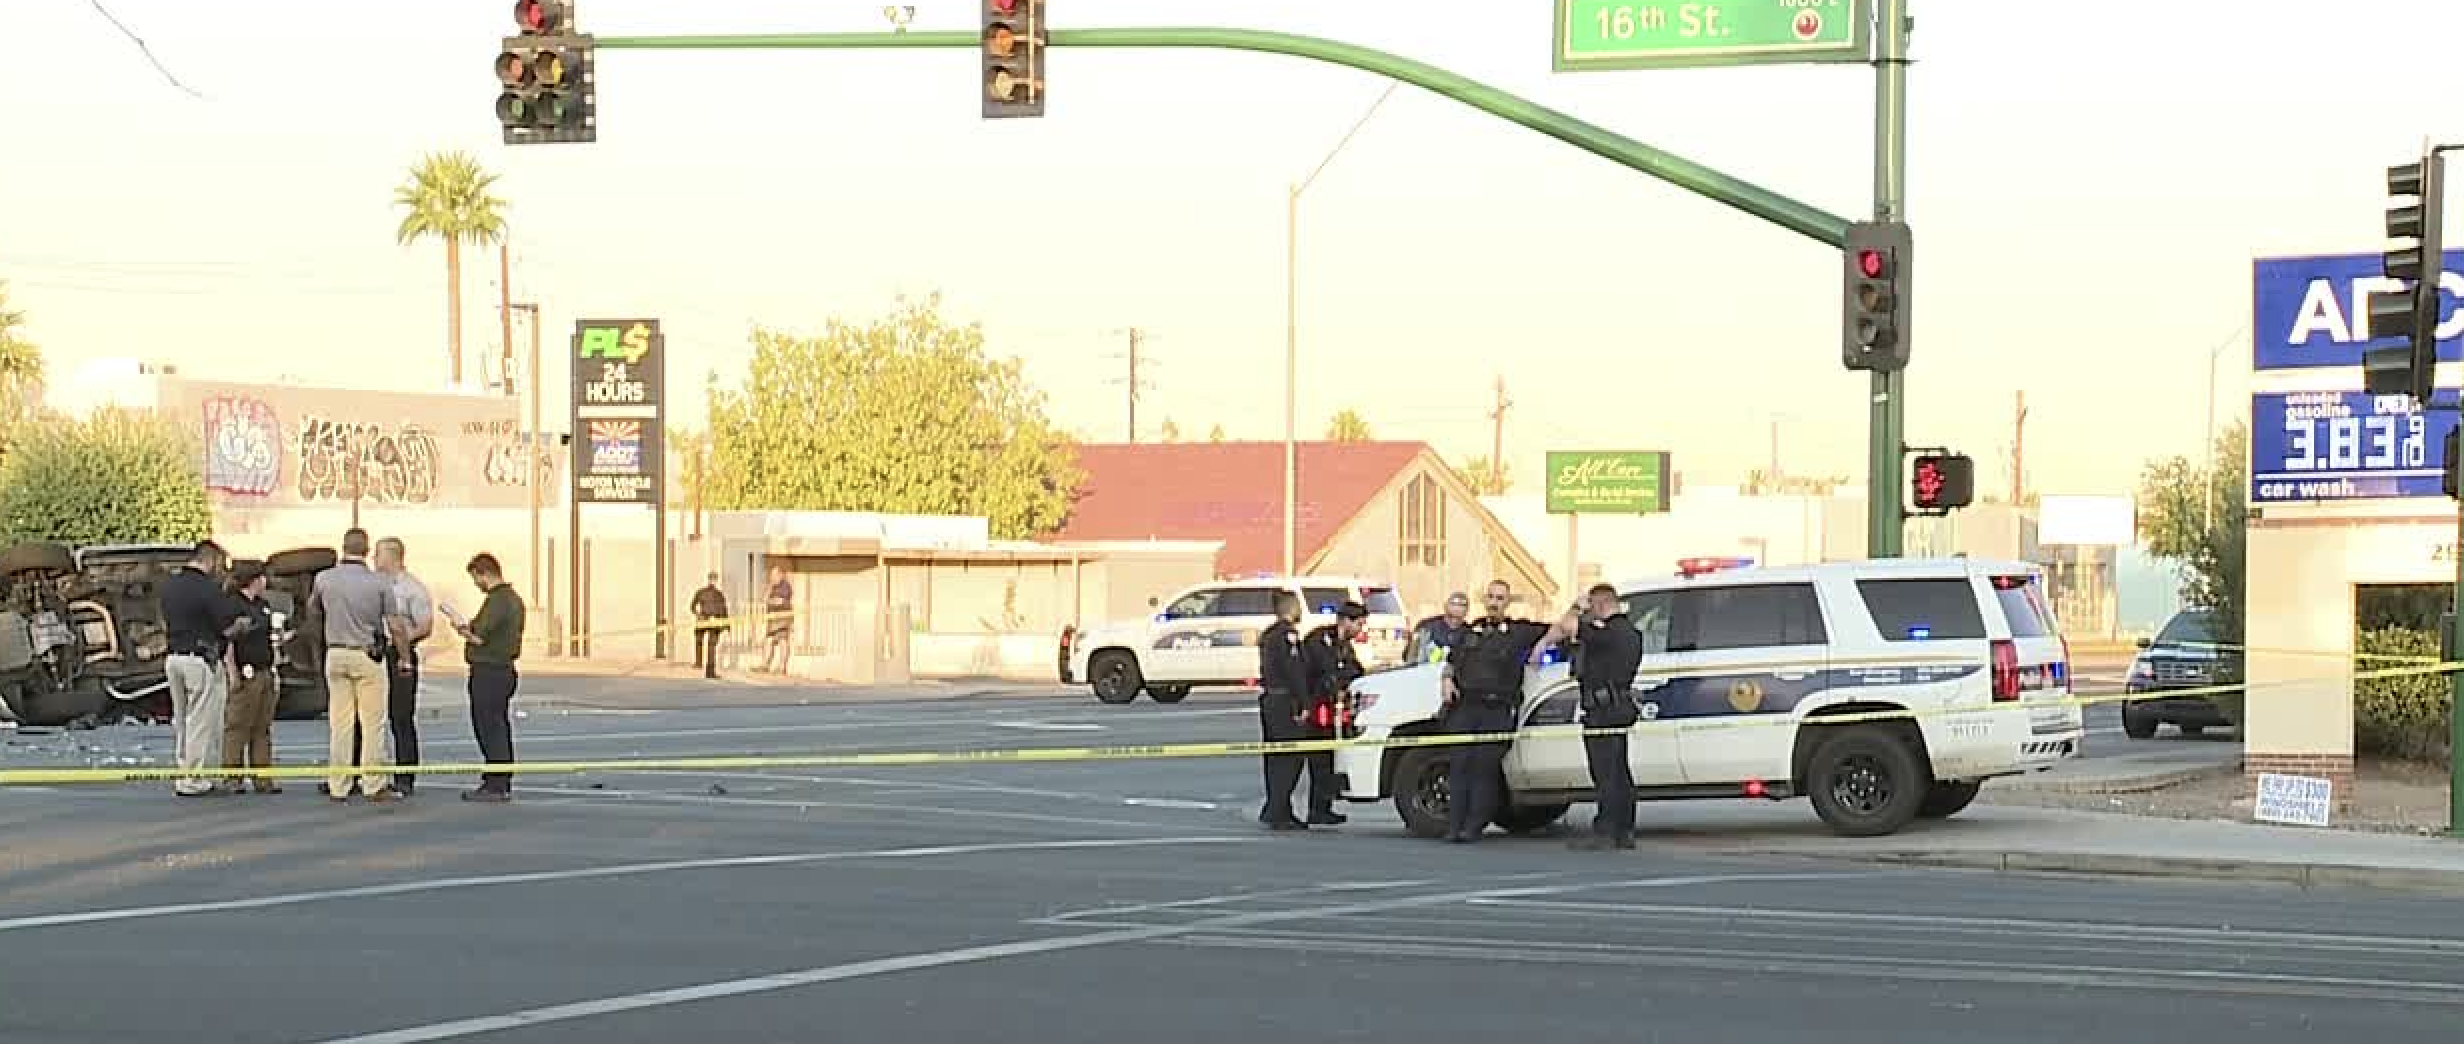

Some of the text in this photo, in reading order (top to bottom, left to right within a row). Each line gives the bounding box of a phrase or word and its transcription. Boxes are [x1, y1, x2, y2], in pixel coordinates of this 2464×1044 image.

[1597, 5, 1731, 39] 16th St.
[603, 363, 627, 382] 24
[586, 382, 643, 402] HOURS
[2285, 404, 2351, 420] gasoline
[580, 476, 650, 488] MOTOR VEHICLE
[2259, 477, 2355, 498] car wash
[593, 488, 637, 499] SERVICES
